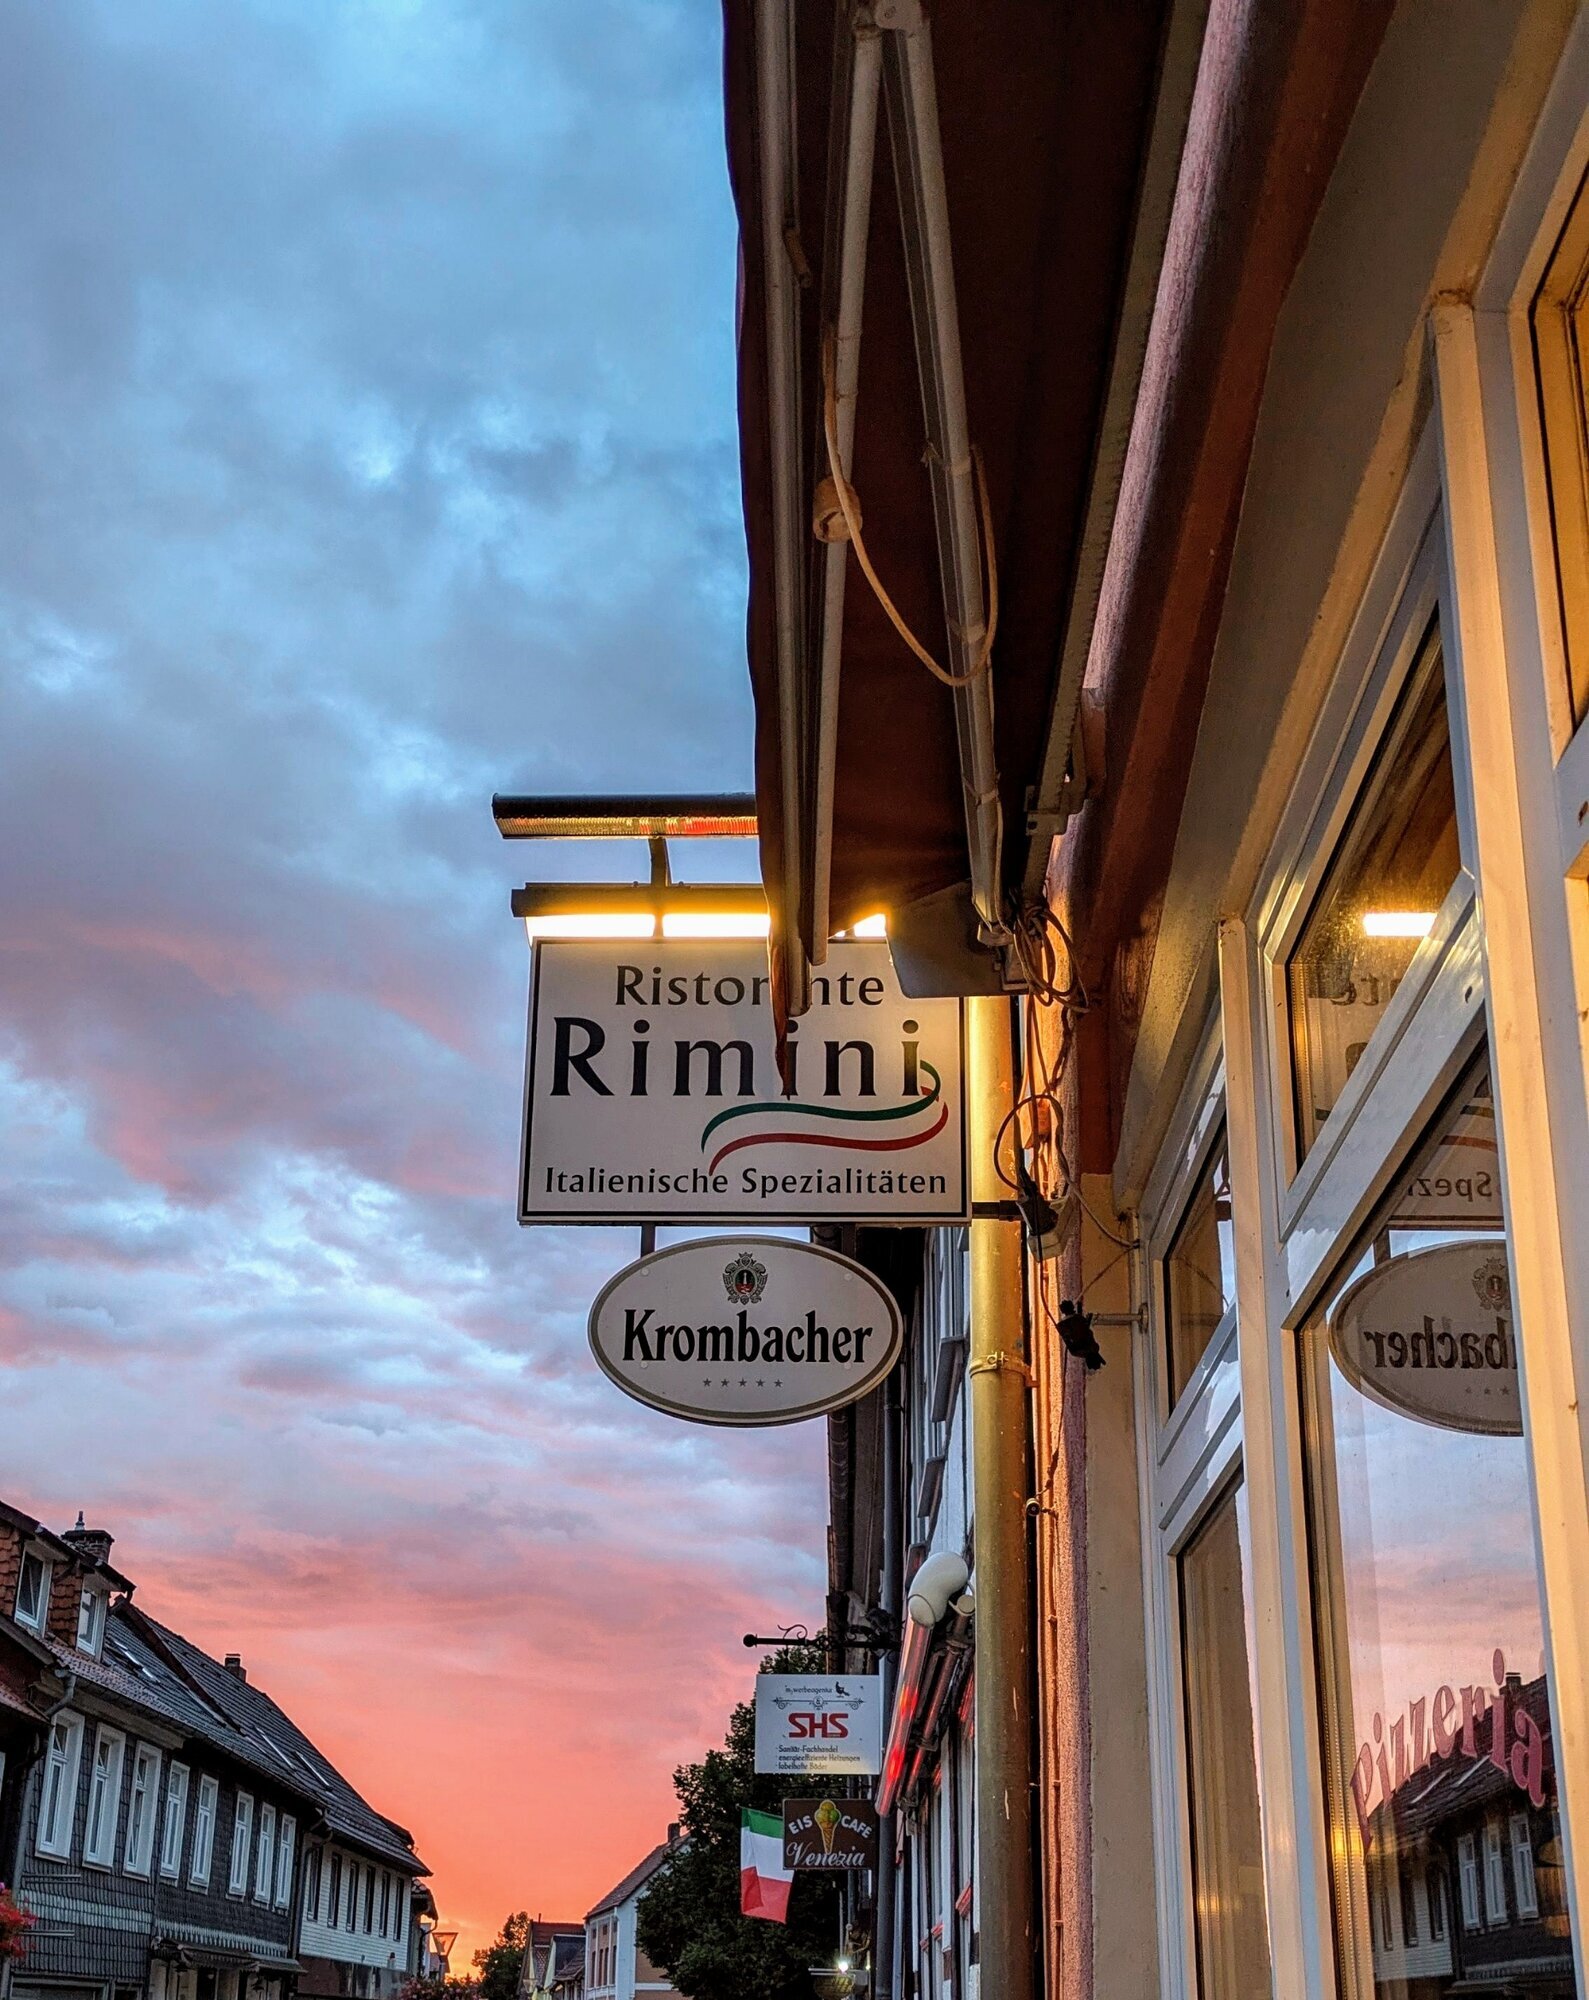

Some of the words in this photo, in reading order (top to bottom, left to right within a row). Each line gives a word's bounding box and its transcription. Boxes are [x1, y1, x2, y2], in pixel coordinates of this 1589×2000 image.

[615, 965, 885, 1006] Ristornte
[549, 1017, 921, 1097] Rimini
[545, 1167, 728, 1194] Italienische
[742, 1167, 947, 1199] Spezialitäten
[622, 1309, 873, 1363] Krombacher
[788, 1712, 849, 1738] SHS
[788, 1815, 813, 1835] EIS
[841, 1815, 873, 1839] CAFE
[786, 1841, 866, 1868] Venezia
